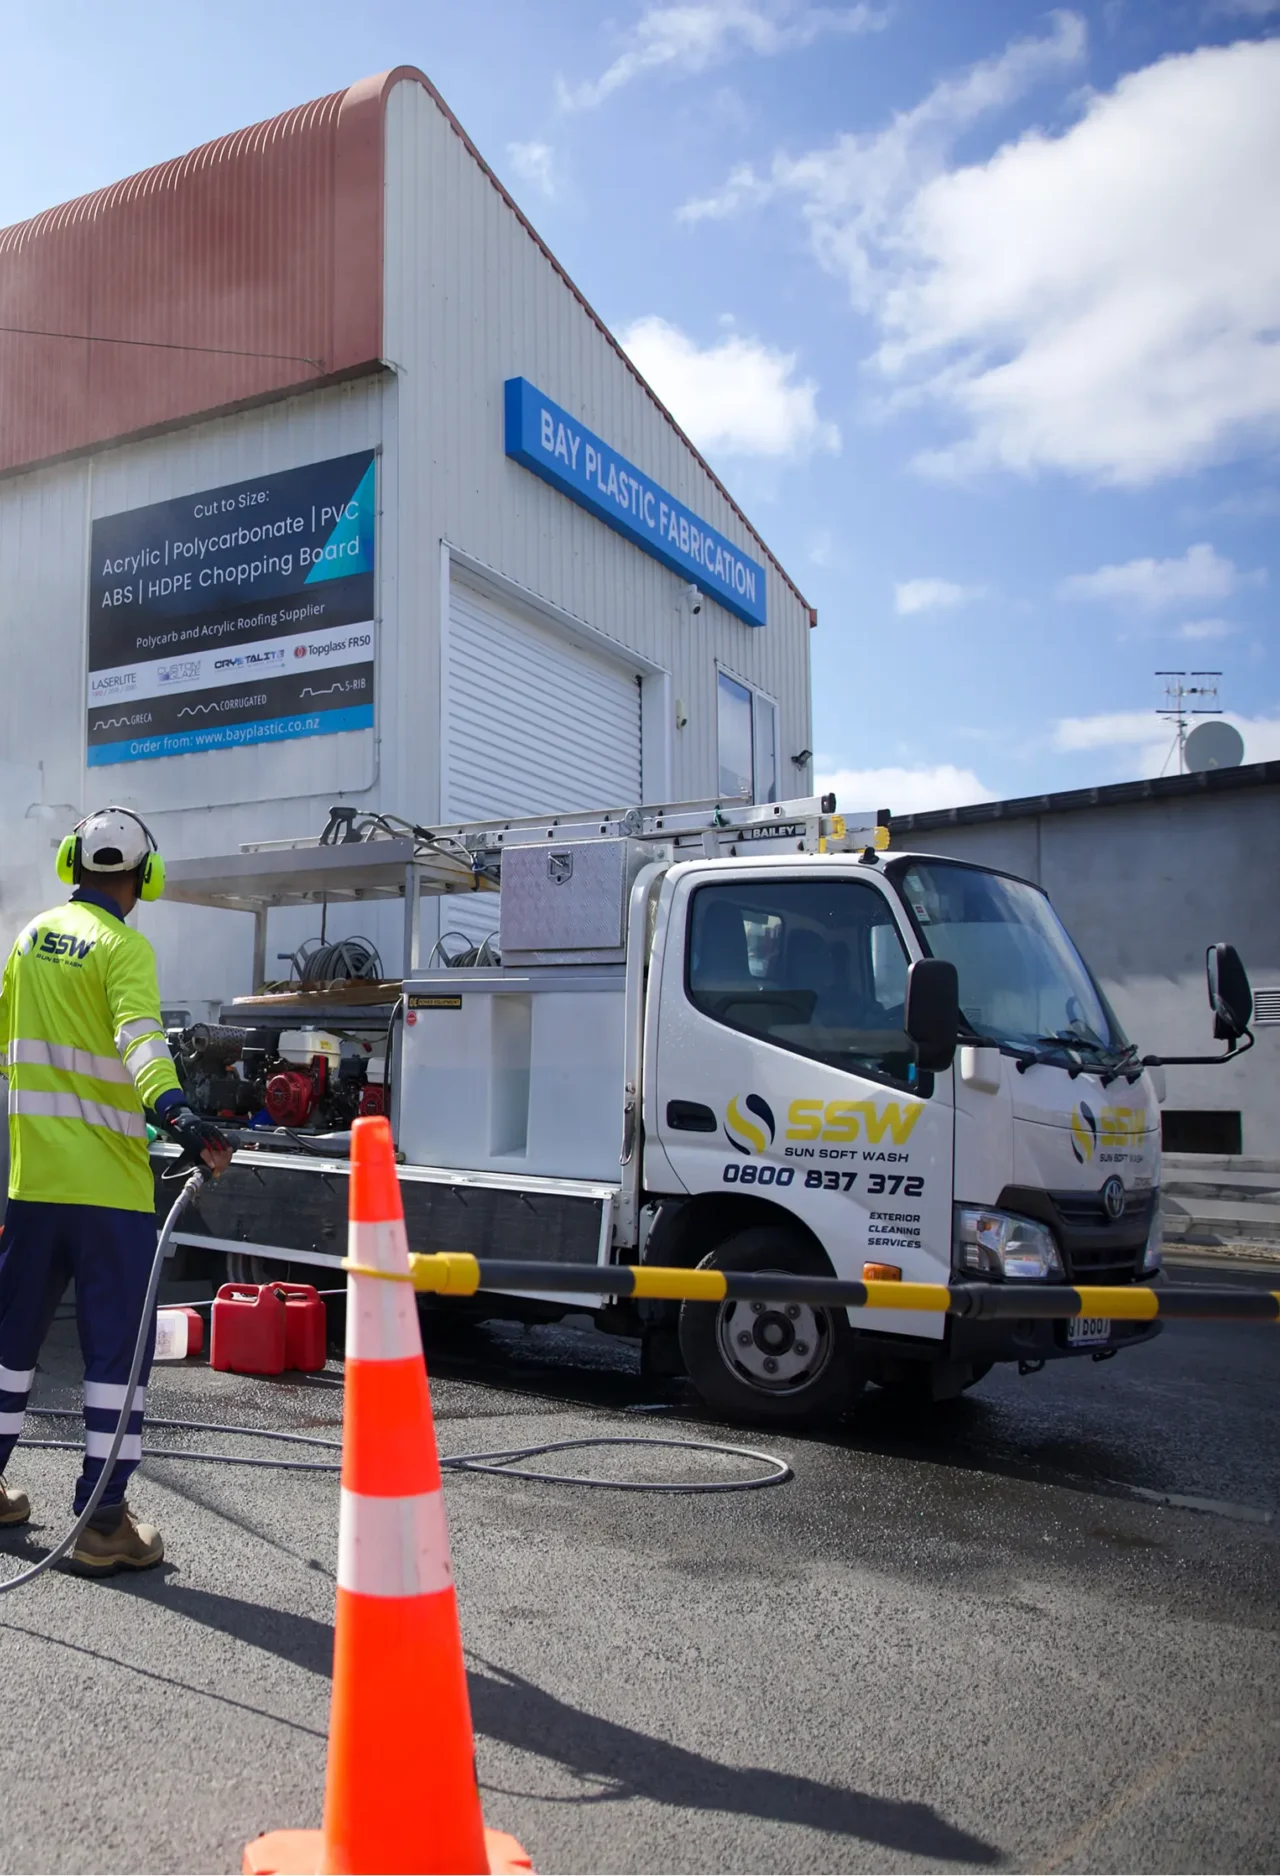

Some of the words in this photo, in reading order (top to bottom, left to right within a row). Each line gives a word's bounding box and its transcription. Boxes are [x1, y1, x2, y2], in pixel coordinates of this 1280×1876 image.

[194, 502, 218, 518] Cut
[221, 499, 235, 512] to
[238, 490, 269, 508] Size:
[540, 408, 580, 470] BAY
[585, 443, 655, 529] PLASTIC
[659, 500, 756, 603] FABRICATION
[102, 548, 160, 576] Acrylic
[173, 516, 304, 560] Polycarbonate
[321, 501, 359, 526] PVC
[102, 586, 133, 608] ABS
[148, 573, 192, 598] HDPE
[199, 553, 293, 587] Chopping
[300, 535, 359, 566] Board
[136, 631, 178, 648] Polycarb
[180, 626, 199, 640] and
[201, 620, 235, 637] Acrylic
[237, 612, 278, 629] Roofing
[279, 603, 325, 622] Supplier
[308, 640, 346, 656] Topglass
[348, 635, 370, 648] FR50
[92, 673, 137, 690] LASERLITE
[220, 694, 267, 711] CORRUGATED
[131, 713, 152, 725] GRECA
[130, 739, 161, 755] Order
[164, 736, 193, 749] from:
[195, 717, 320, 745] www.bayplastic.co.nz
[754, 826, 795, 838] BAILEY
[40, 931, 95, 959] SSW
[785, 1099, 926, 1145] SSW
[785, 1147, 815, 1158] SUN
[818, 1149, 858, 1160] SOFT
[862, 1151, 909, 1163] WASH
[723, 1163, 795, 1186] 0800
[804, 1169, 858, 1192] 837
[867, 1173, 925, 1197] 372
[869, 1211, 920, 1223] EXTERIOR
[868, 1224, 920, 1236] CLEANING
[867, 1237, 922, 1249] SERVICES
